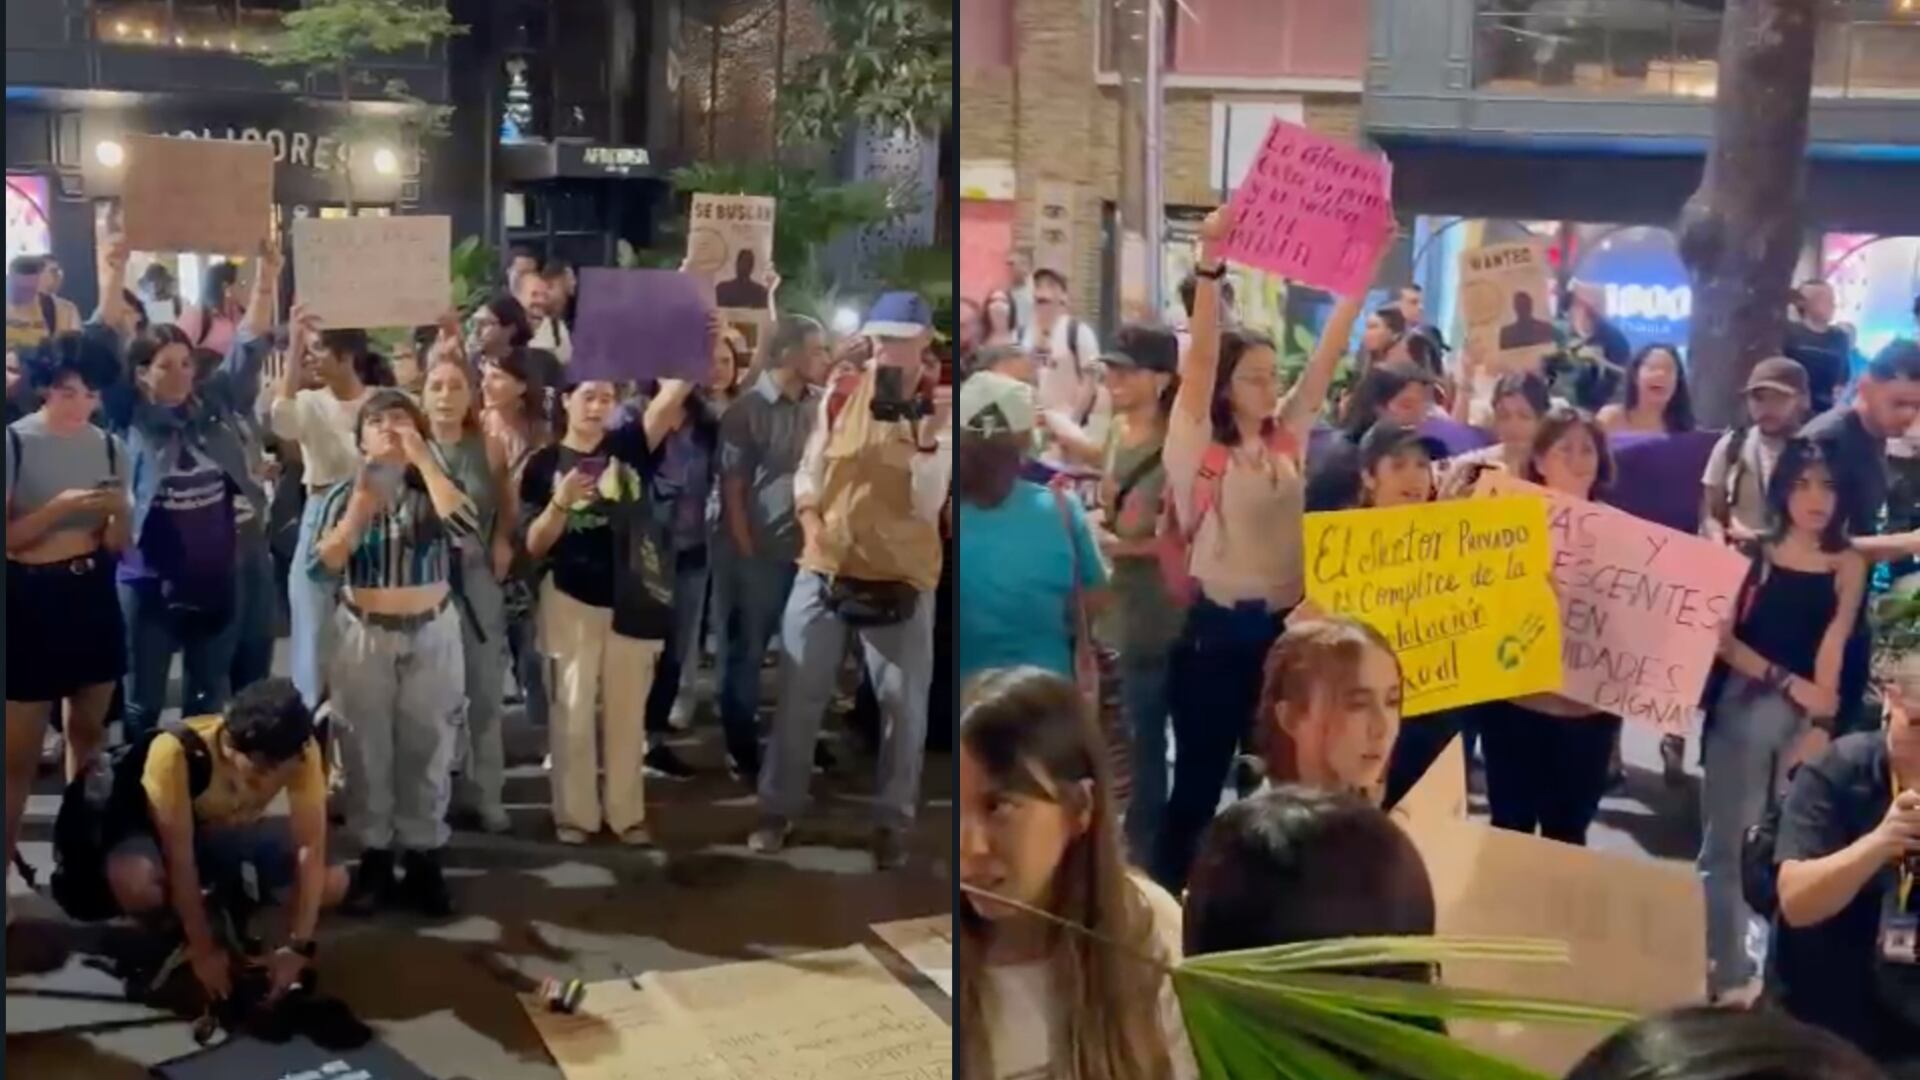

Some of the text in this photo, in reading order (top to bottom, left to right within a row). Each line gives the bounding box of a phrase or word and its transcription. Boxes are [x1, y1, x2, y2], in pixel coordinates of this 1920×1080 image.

[695, 202, 713, 219] SE
[1313, 524, 1353, 584] El
[1358, 519, 1445, 576] Sector
[1471, 562, 1495, 587] de
[1504, 552, 1528, 581] la
[1565, 598, 1609, 637] EN
